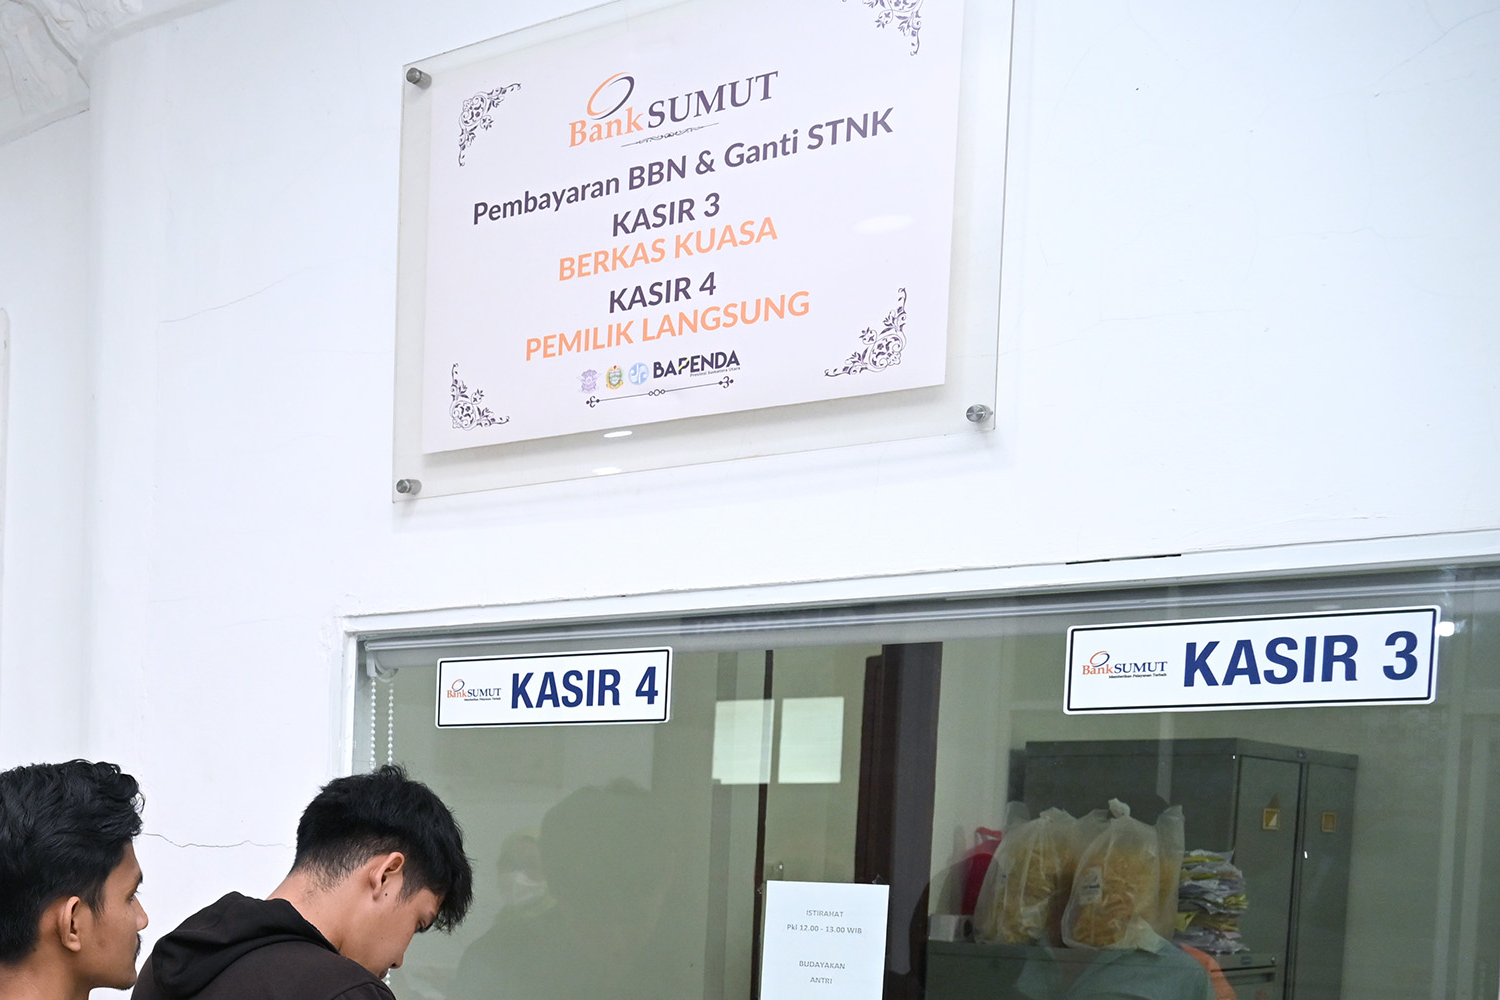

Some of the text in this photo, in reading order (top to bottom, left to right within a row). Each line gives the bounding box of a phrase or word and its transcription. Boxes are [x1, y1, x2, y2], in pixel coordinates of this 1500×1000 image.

[473, 107, 894, 225] Pembayaran BBN & Ganti STNK
[612, 192, 721, 237] KASIR 3
[558, 216, 779, 281] BERKAS KUASA
[608, 271, 717, 314] KASIR 4
[525, 290, 810, 361] PEMILIK LANGSUNG
[652, 350, 741, 379] BAPENDA
[1183, 630, 1418, 688] KASIR 3
[511, 666, 659, 709] KASIR 4
[800, 924, 819, 933] 12.00
[825, 926, 846, 934] 13.00
[847, 927, 863, 935] WIB
[806, 909, 844, 918] ISTIRAHAT
[799, 960, 846, 970] BUDAYAKAN
[810, 976, 833, 985] ANTRI
